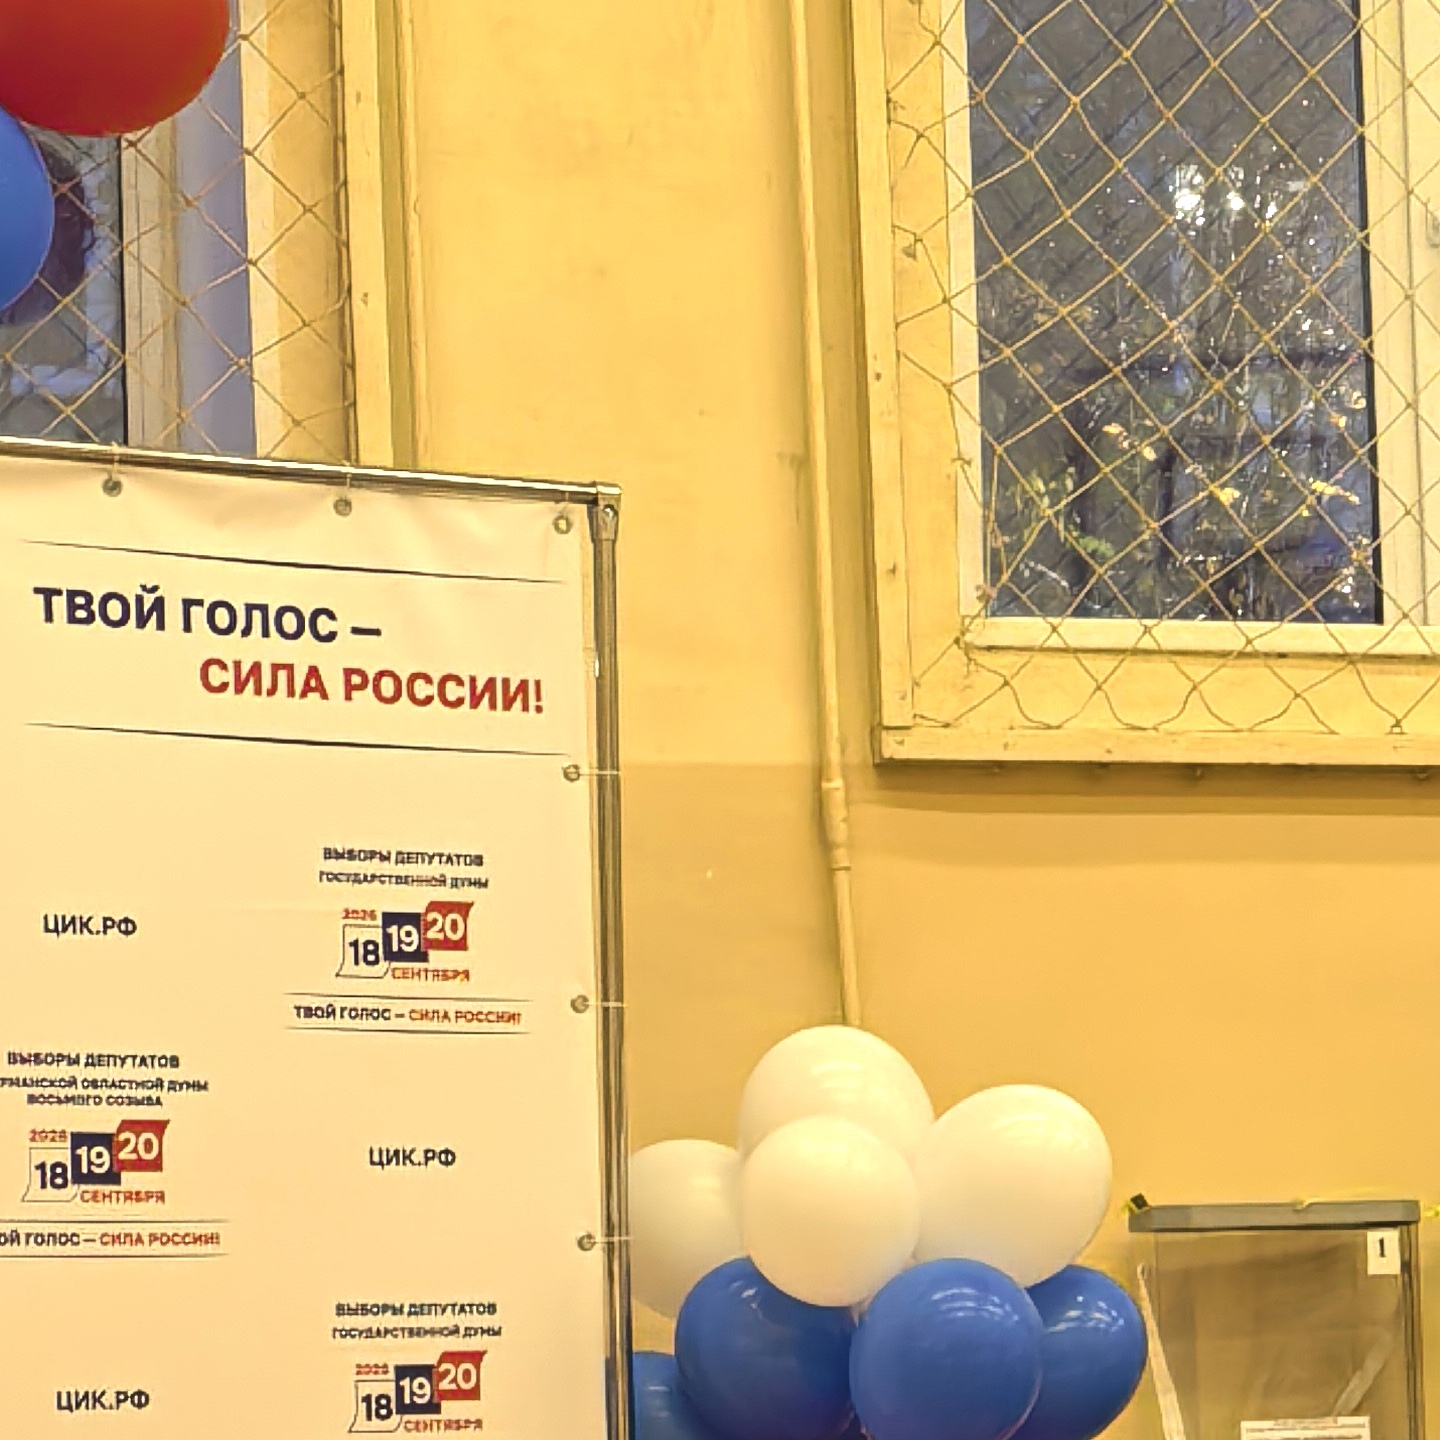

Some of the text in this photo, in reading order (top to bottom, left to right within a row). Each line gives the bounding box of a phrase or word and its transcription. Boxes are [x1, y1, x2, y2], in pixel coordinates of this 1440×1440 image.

[34, 584, 165, 631] ТВОЙ
[182, 600, 338, 643] ГОЛОС
[200, 658, 544, 714] СИЛА РОССИИ!
[323, 848, 484, 866] ВЫБОРЫ ДЕПУТАТОВ
[43, 914, 137, 940] ЦИК.РФ
[348, 912, 464, 966] 18 19 20
[391, 967, 469, 982] СЕНТЯБРЯ
[294, 1004, 335, 1020] ТВОЙ
[340, 1005, 391, 1021] ГОЛОС
[409, 1009, 450, 1023] СИЛА
[8, 1051, 179, 1068] ВЫБОРЫ ДЕПУТАТОВ
[34, 1131, 158, 1190] 18 19 20
[368, 1146, 457, 1170] ЦИК.РФ
[80, 1190, 165, 1204] СЕНТЯБРЯ
[25, 1233, 80, 1247] ГОЛОС
[100, 1232, 144, 1246] СИЛА
[1378, 1238, 1386, 1258] 1
[335, 1303, 497, 1317] ВЫБОРЫ ДЕПУТАТОВ
[56, 1389, 150, 1413] ЦИК.РФ
[361, 1363, 477, 1422] 18 19 20
[403, 1419, 483, 1432] СЕНТЯБРЯ
